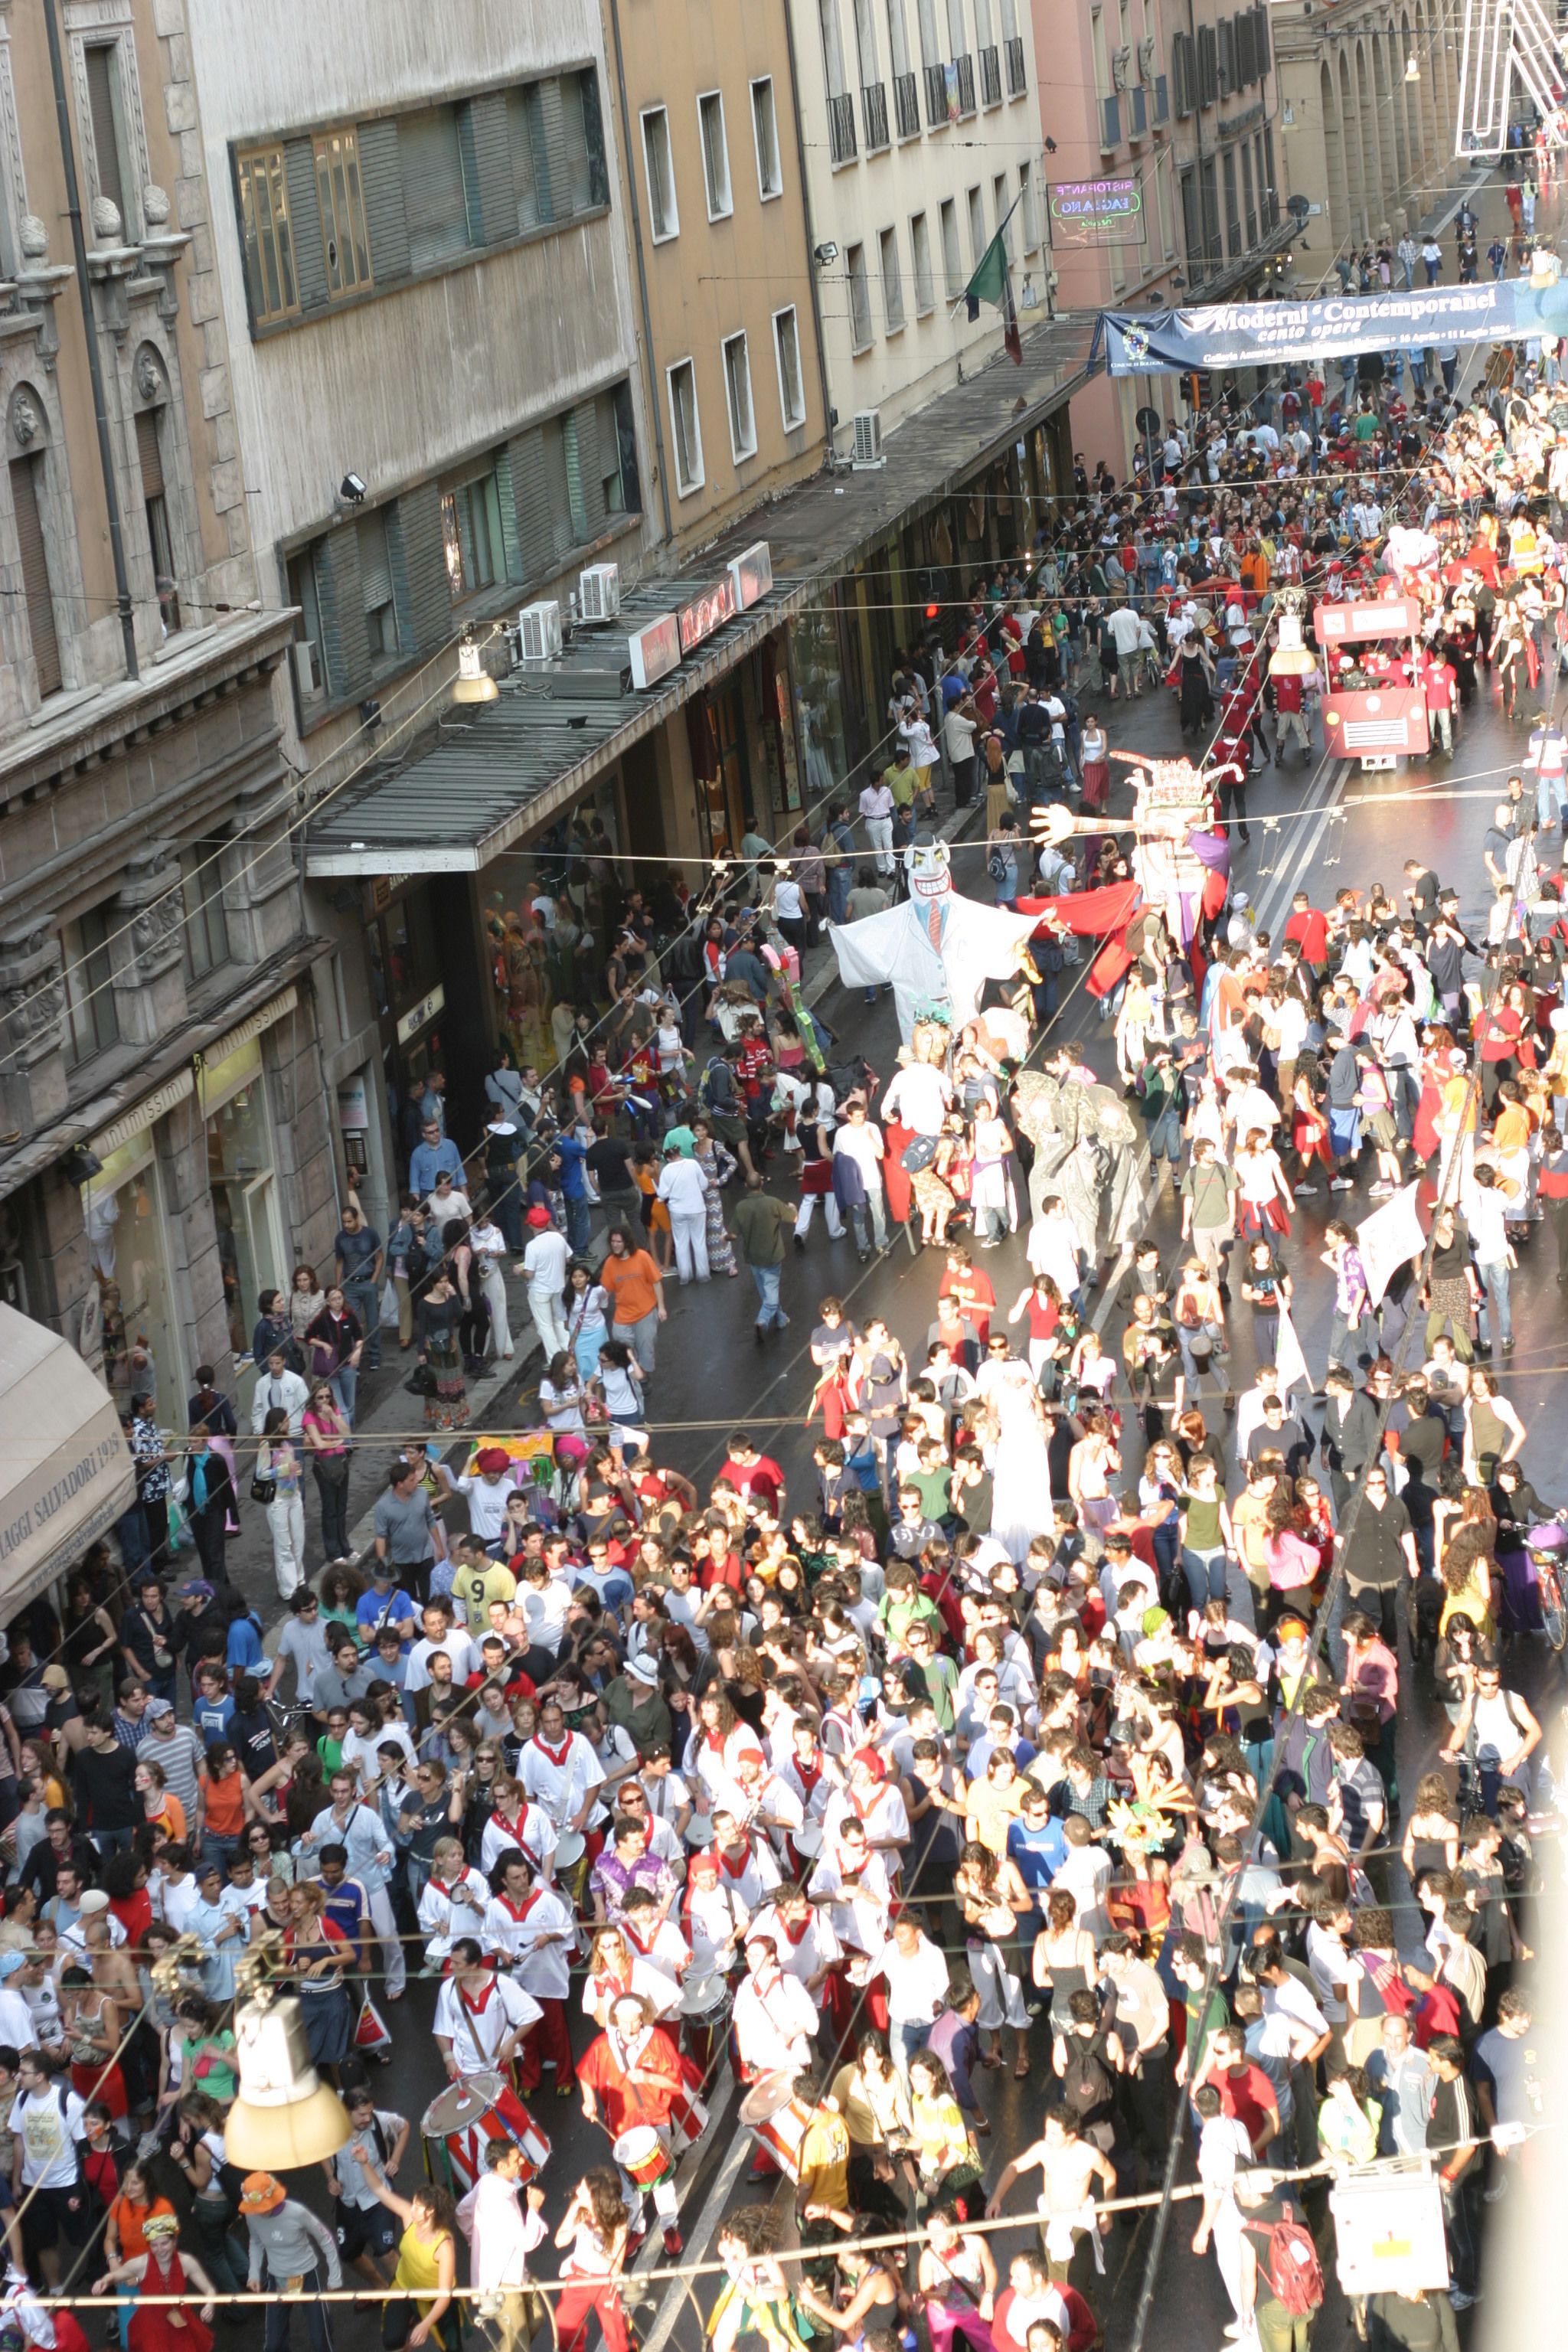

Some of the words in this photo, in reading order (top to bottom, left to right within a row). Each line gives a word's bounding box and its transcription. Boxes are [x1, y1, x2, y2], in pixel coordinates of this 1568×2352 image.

[1210, 305, 1308, 334] Moderni
[1324, 288, 1496, 322] Contemporanei
[1257, 326, 1305, 343] cento
[1311, 321, 1361, 340] opere
[103, 1077, 185, 1152] intimissimi
[34, 1452, 98, 1527] SALVADORI
[96, 1432, 119, 1468] 1929
[471, 1579, 484, 1602] 9
